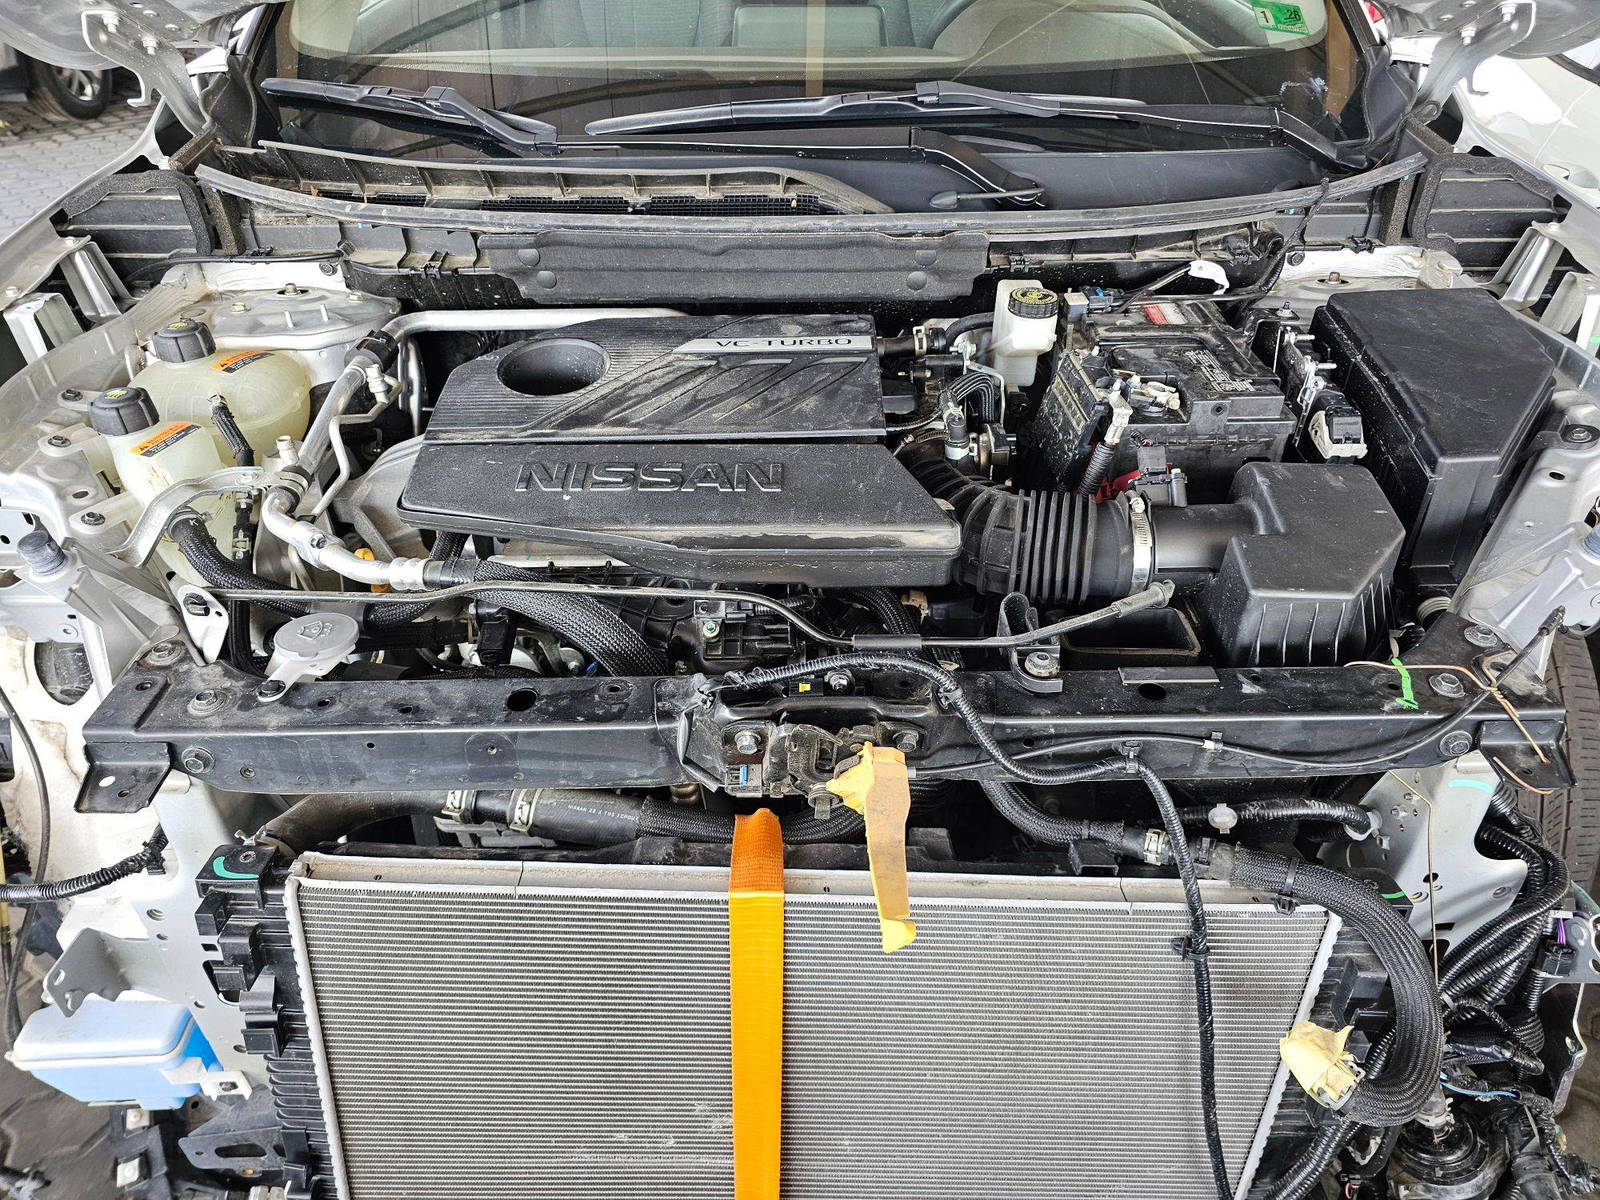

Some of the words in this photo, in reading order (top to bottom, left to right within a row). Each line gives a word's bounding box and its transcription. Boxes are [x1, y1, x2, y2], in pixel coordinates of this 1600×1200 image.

[1261, 11, 1269, 23] 1
[716, 338, 852, 347] VC-TURBO
[514, 461, 784, 493] NISSAN
